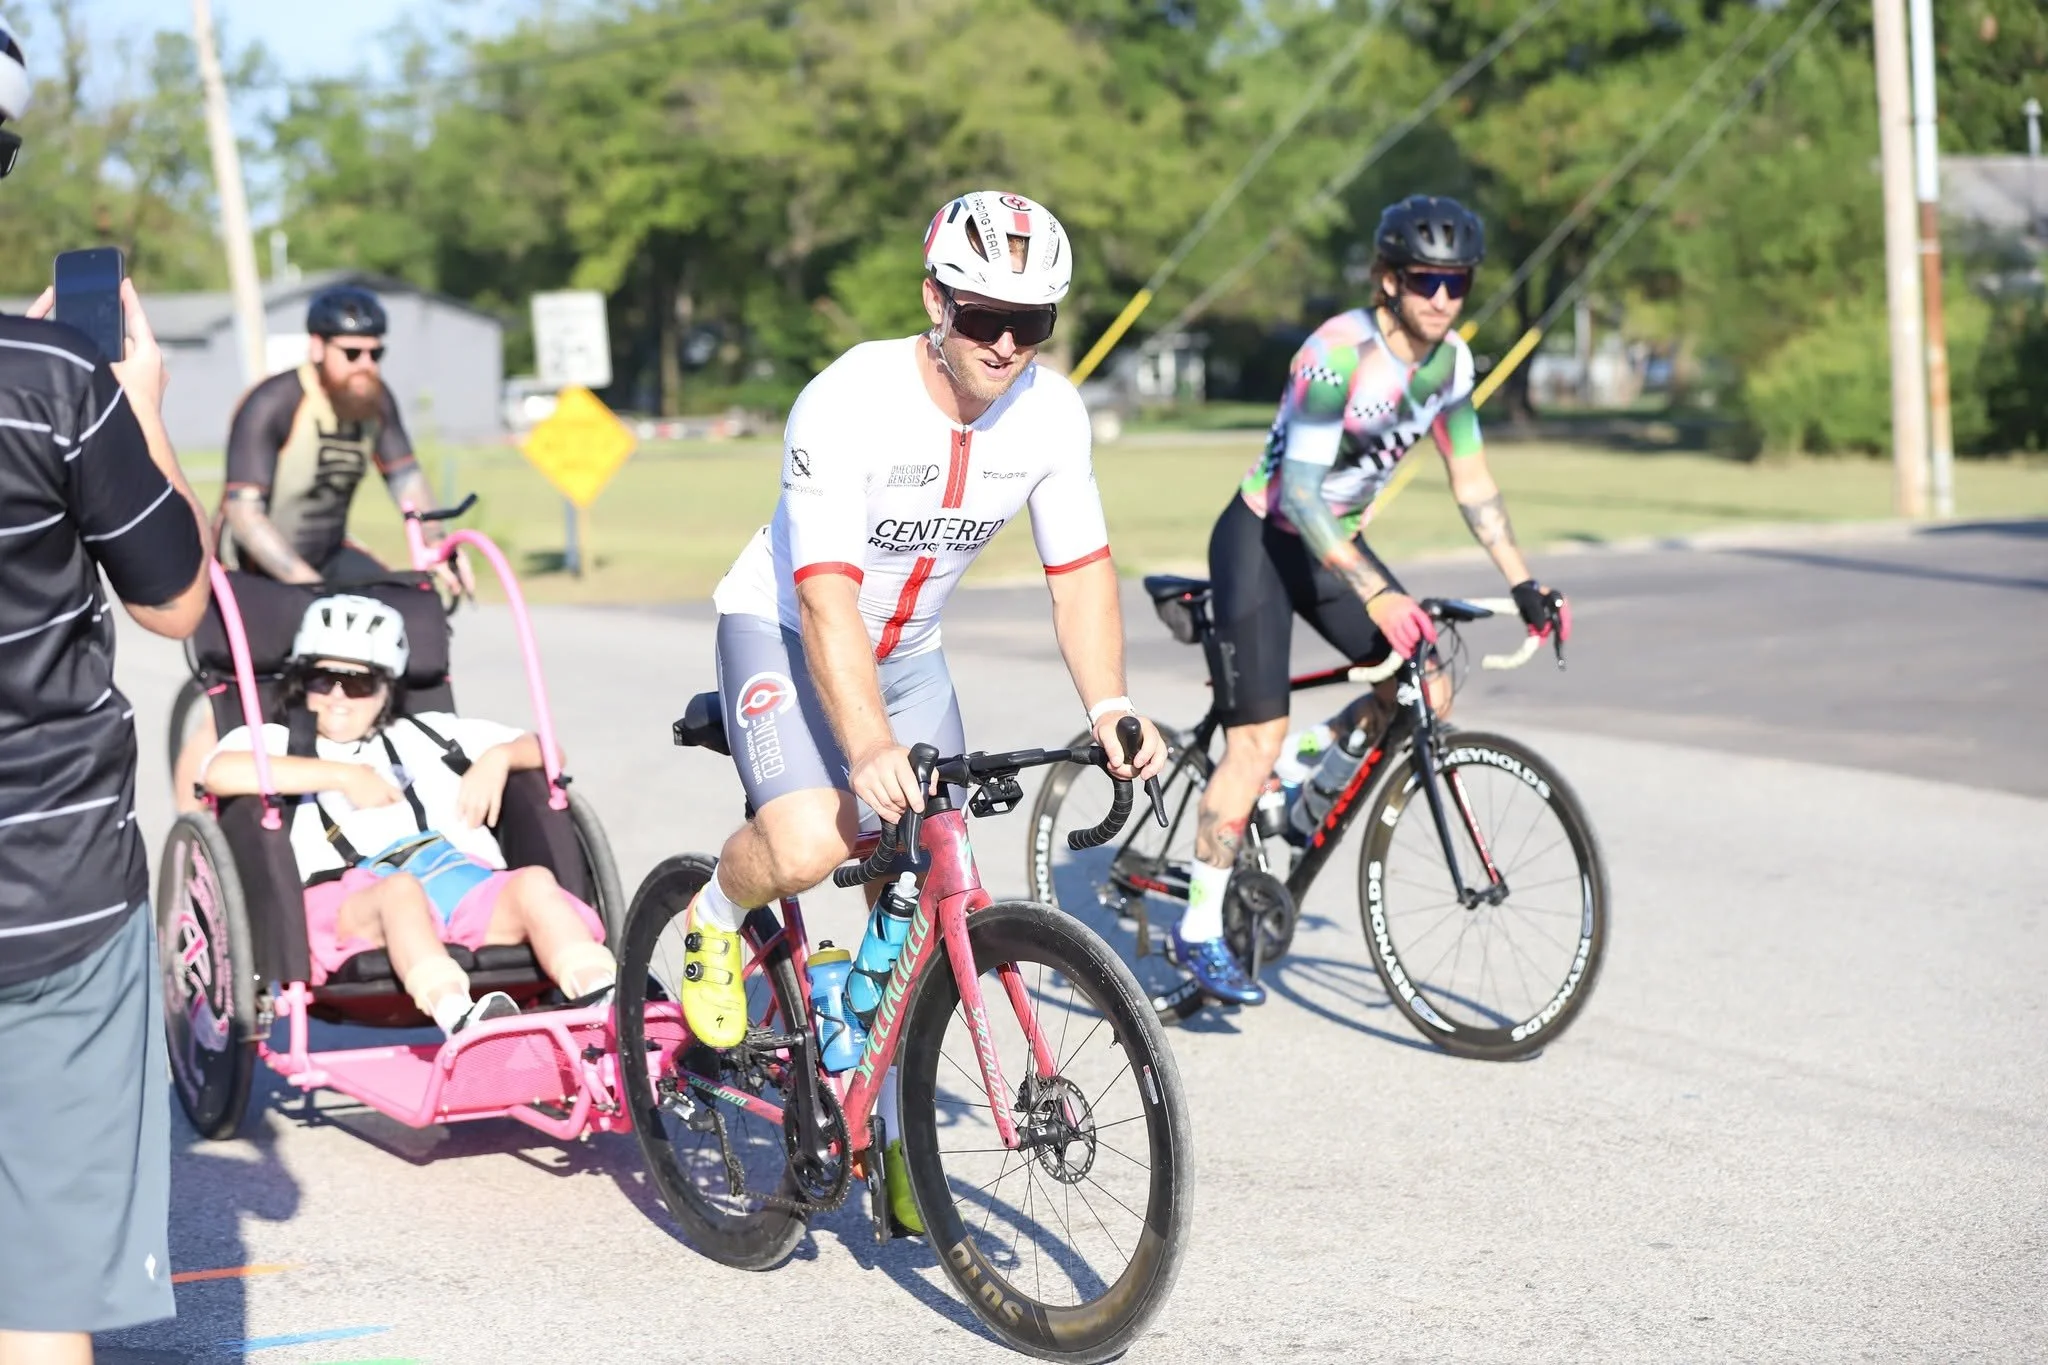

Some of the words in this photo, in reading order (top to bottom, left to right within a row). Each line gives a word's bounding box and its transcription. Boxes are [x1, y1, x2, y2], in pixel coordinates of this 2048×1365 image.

[985, 227, 1002, 260] TEAM
[887, 475, 921, 484] GENESIS
[867, 536, 940, 553] RACING
[875, 517, 1005, 543] CENTERED
[751, 762, 764, 786] TEAM
[1443, 747, 1552, 800] REYNOLDS
[1368, 860, 1416, 1003] REYNOLDS
[856, 902, 931, 1090] SPECIALIZED
[1511, 938, 1592, 1042] REYNOLDS
